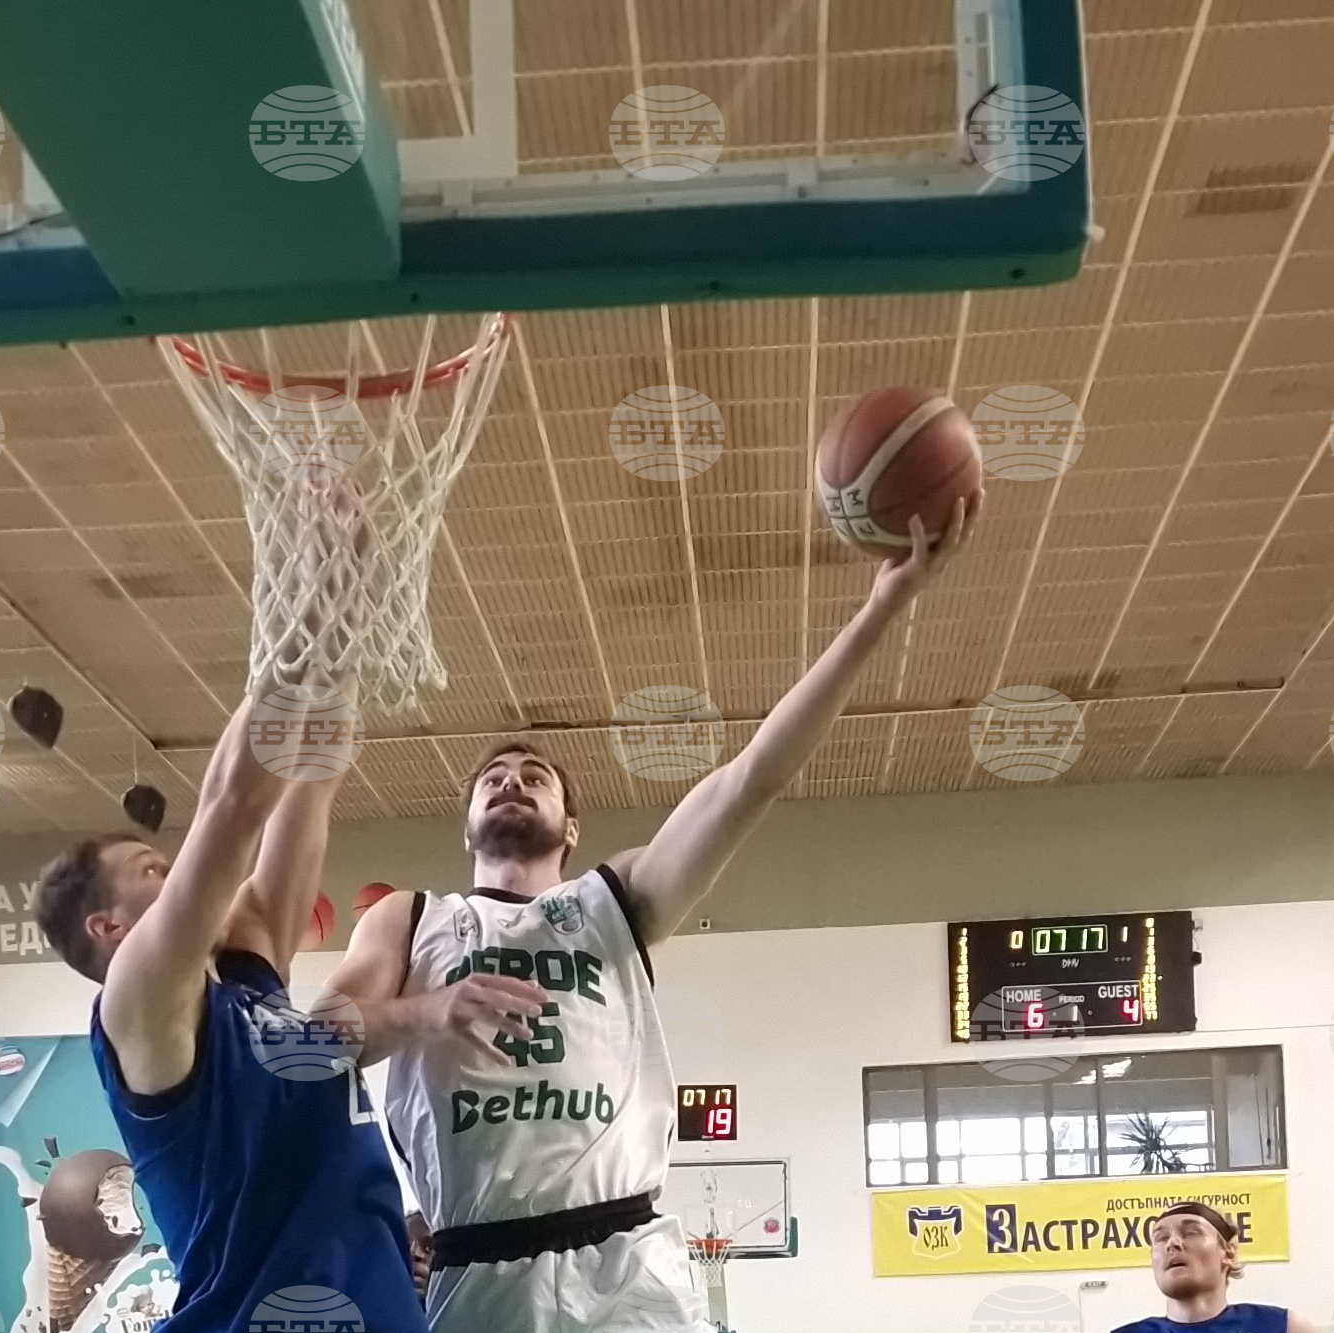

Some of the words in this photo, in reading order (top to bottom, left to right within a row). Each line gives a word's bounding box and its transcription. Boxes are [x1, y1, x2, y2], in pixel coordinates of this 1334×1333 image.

[19, 880, 42, 911] У
[0, 921, 52, 956] ЕД
[1010, 929, 1025, 950] 0
[1006, 989, 1042, 1003] HOME
[1097, 984, 1139, 999] GUEST
[1027, 1002, 1045, 1029] 6
[1122, 999, 1140, 1023] 4
[451, 1079, 615, 1135] Bethub
[707, 1107, 732, 1135] 19
[922, 1225, 950, 1250] ОЗК
